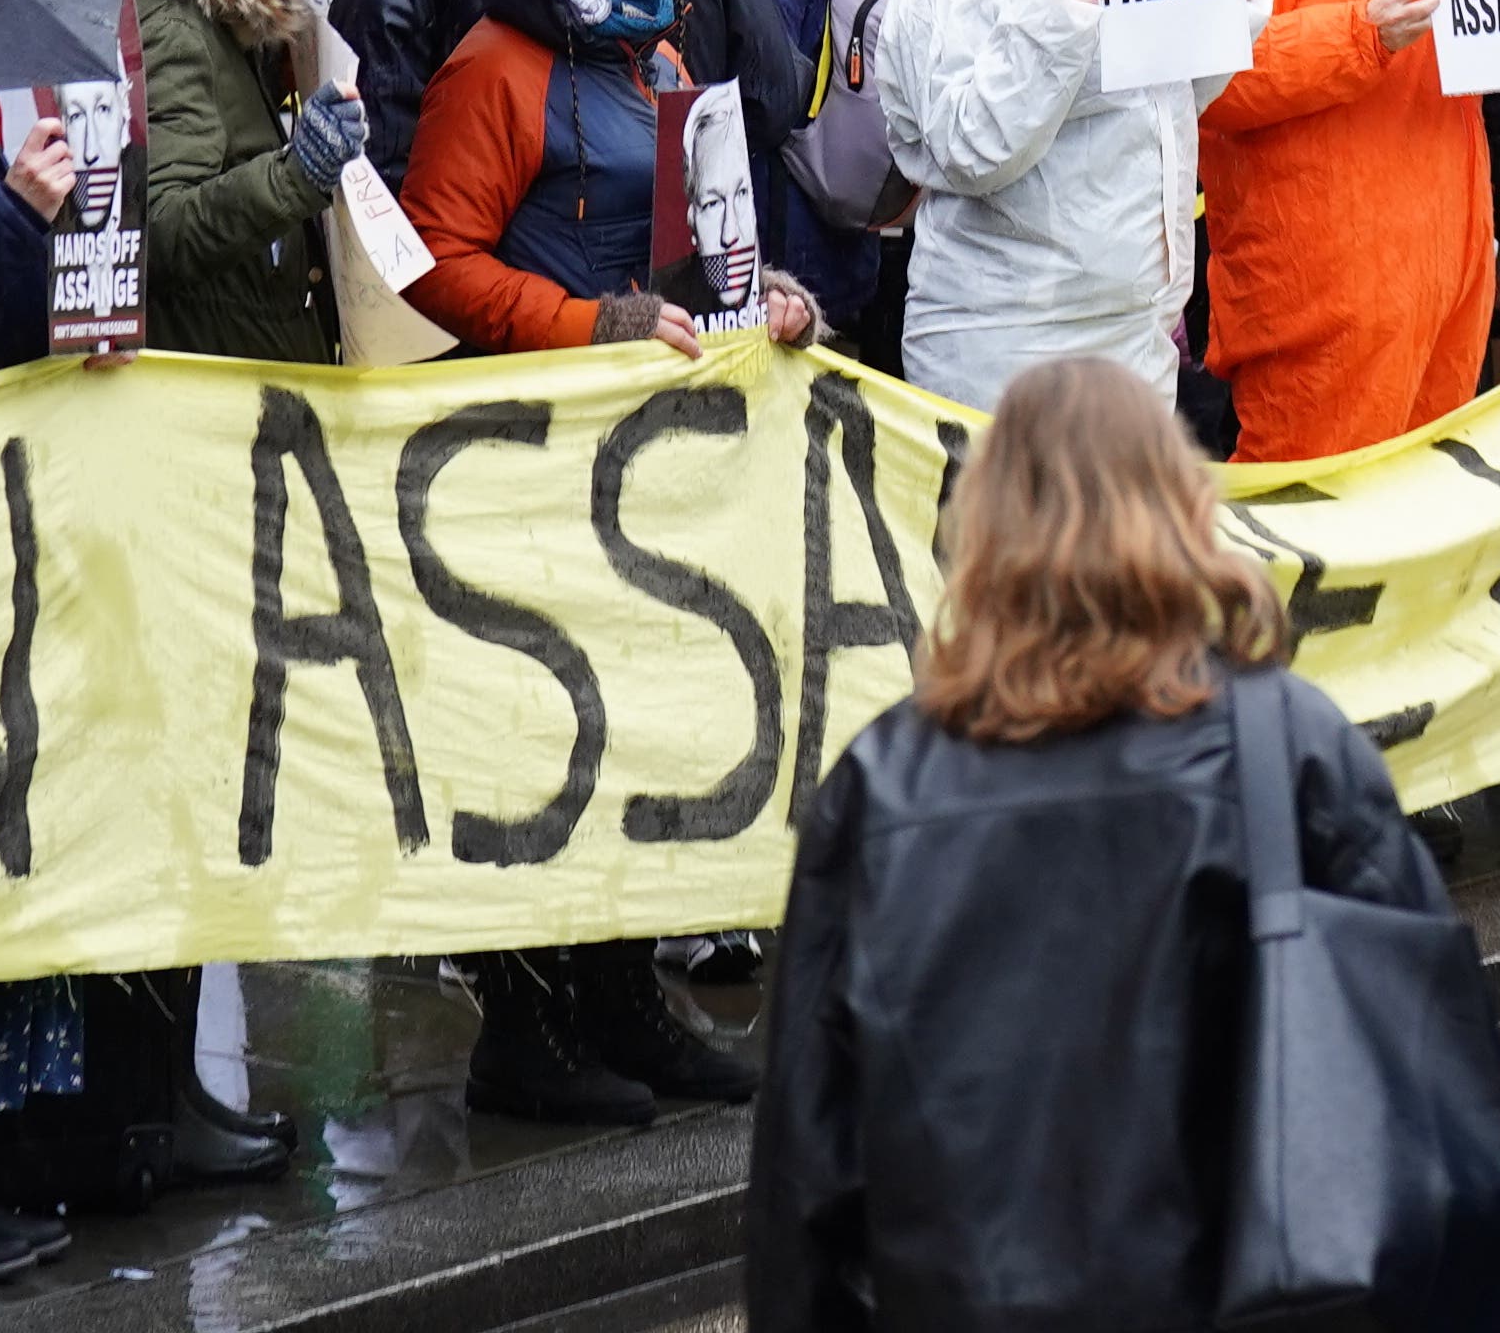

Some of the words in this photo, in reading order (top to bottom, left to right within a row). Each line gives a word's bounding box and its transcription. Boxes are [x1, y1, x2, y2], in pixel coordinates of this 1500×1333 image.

[54, 232, 105, 268] HANDS
[109, 229, 142, 265] OFF
[53, 267, 140, 312] ASSANGE
